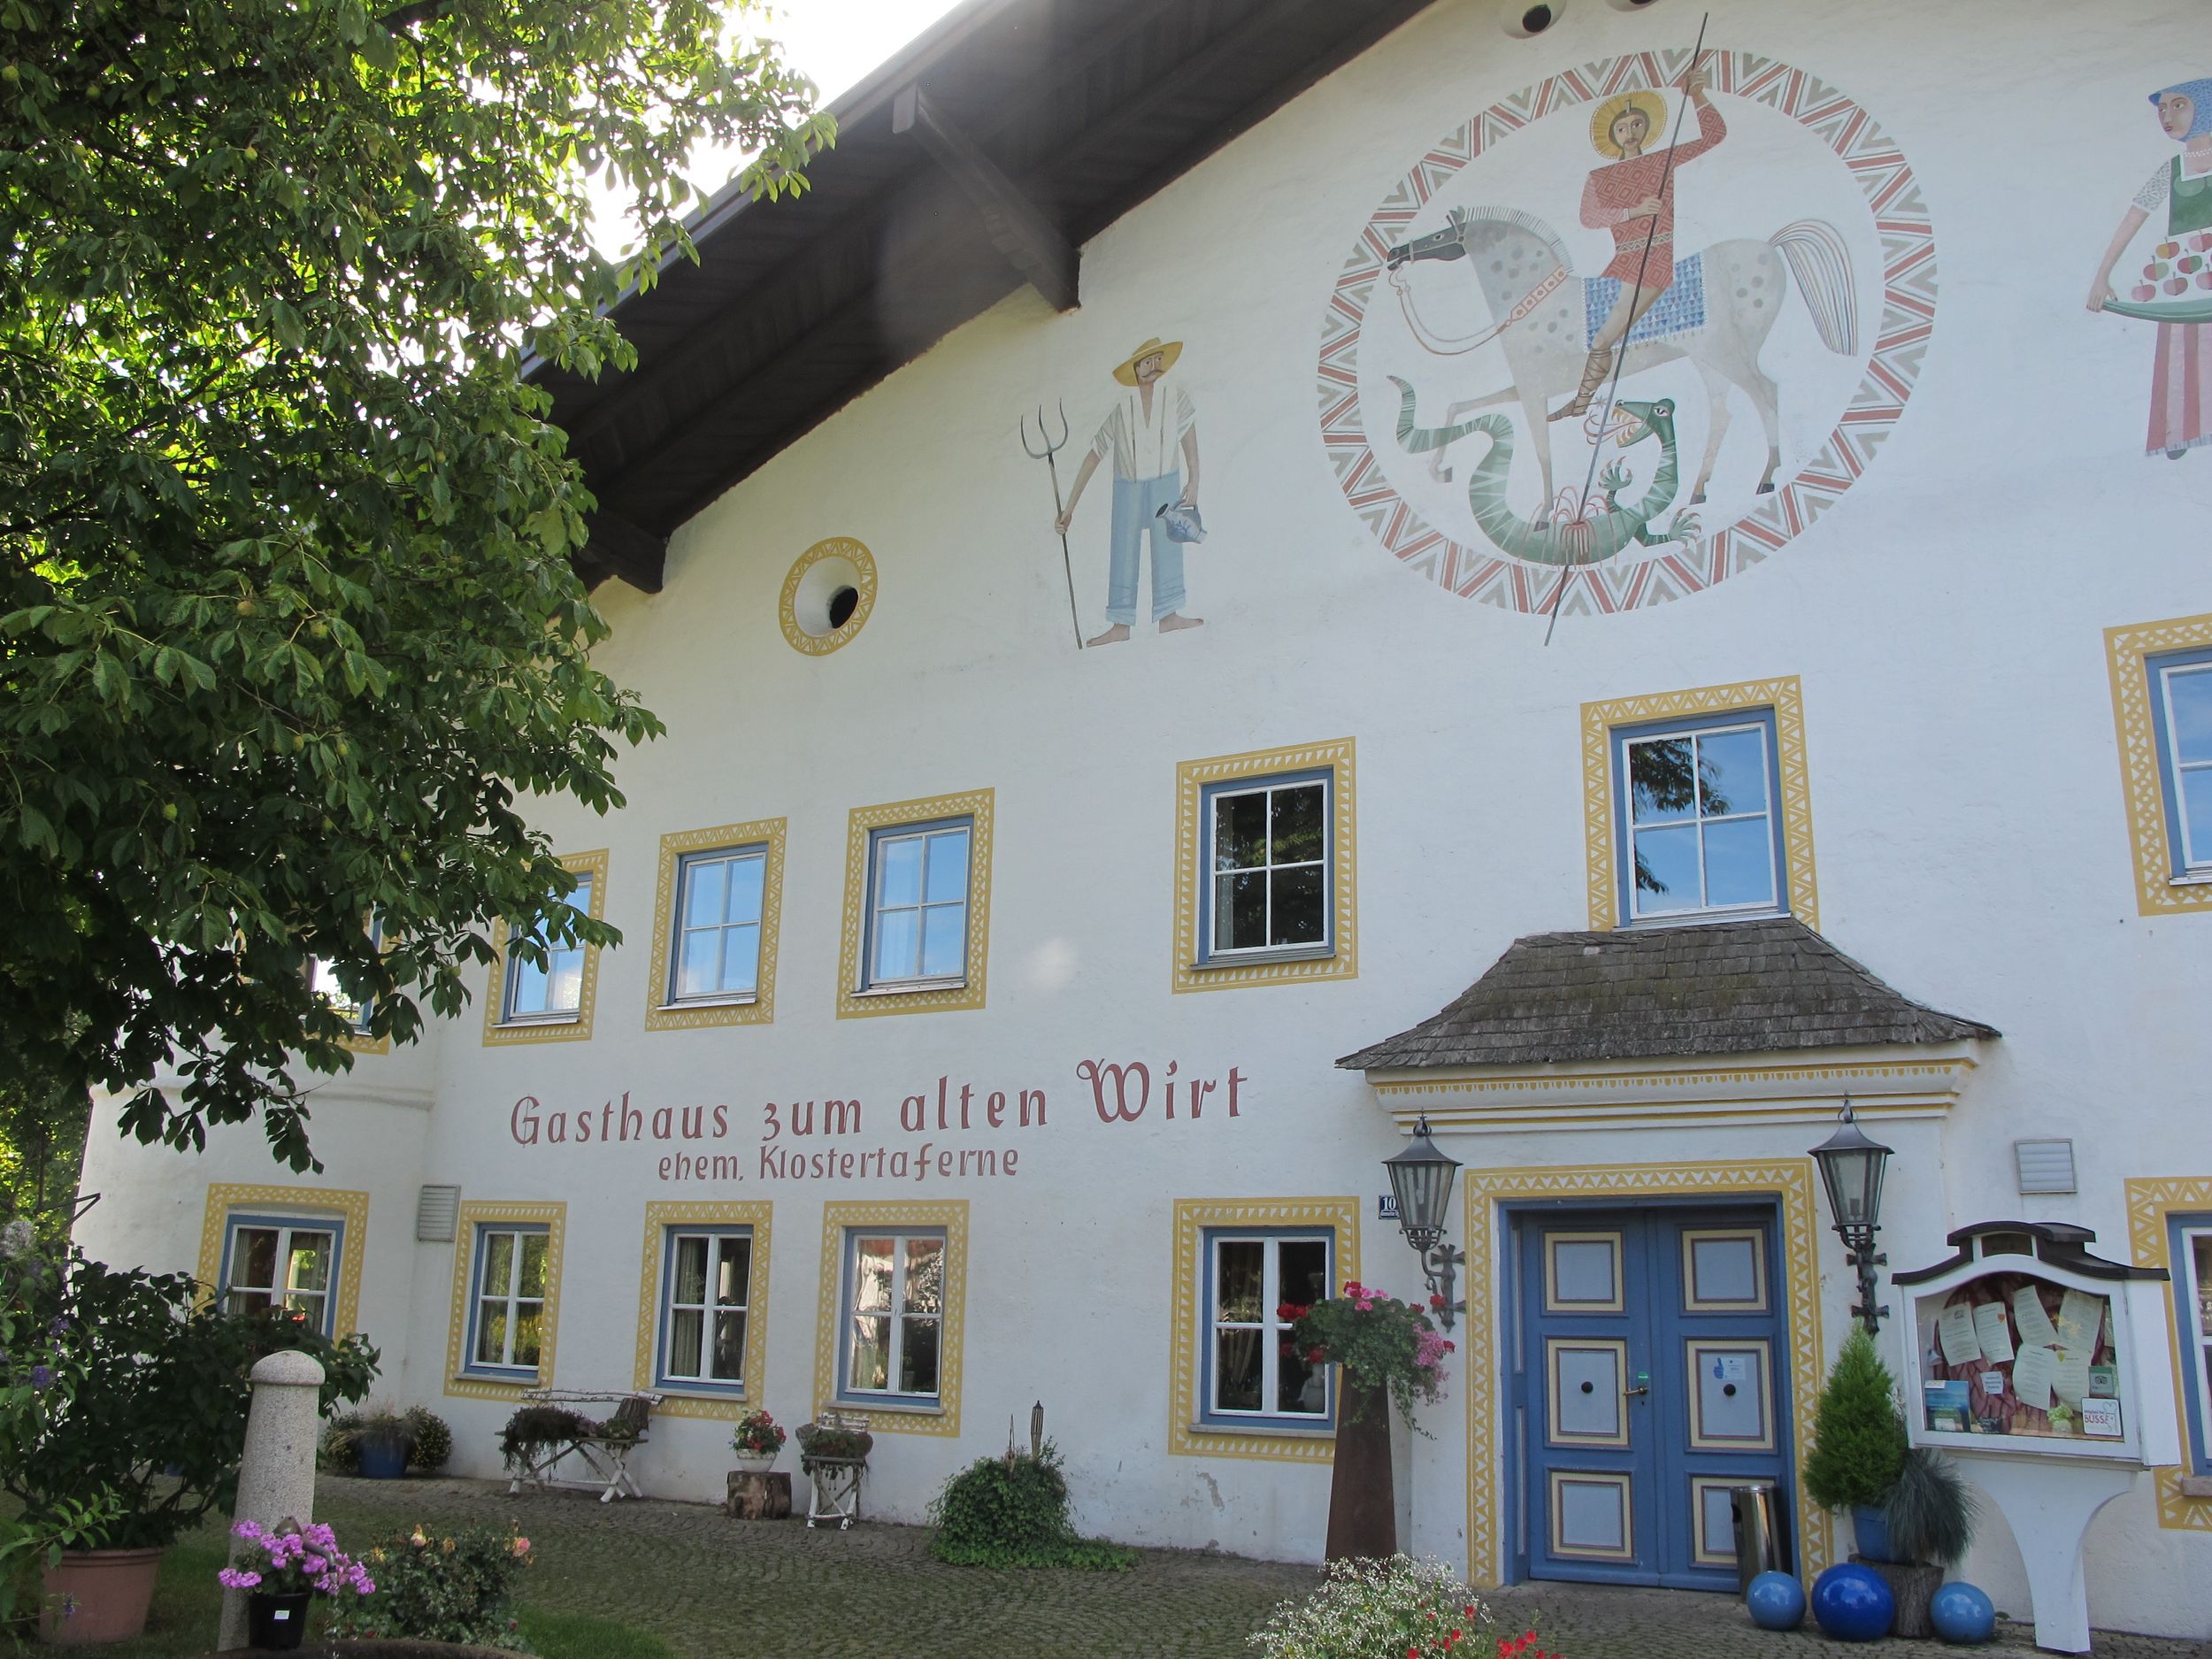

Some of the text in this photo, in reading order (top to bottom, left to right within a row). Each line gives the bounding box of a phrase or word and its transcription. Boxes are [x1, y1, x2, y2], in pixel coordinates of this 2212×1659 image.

[511, 1058, 1248, 1148] Gasthaus zum alten Wirt
[759, 1143, 1018, 1182] Klostertaferne
[1382, 1197, 1396, 1210] 10
